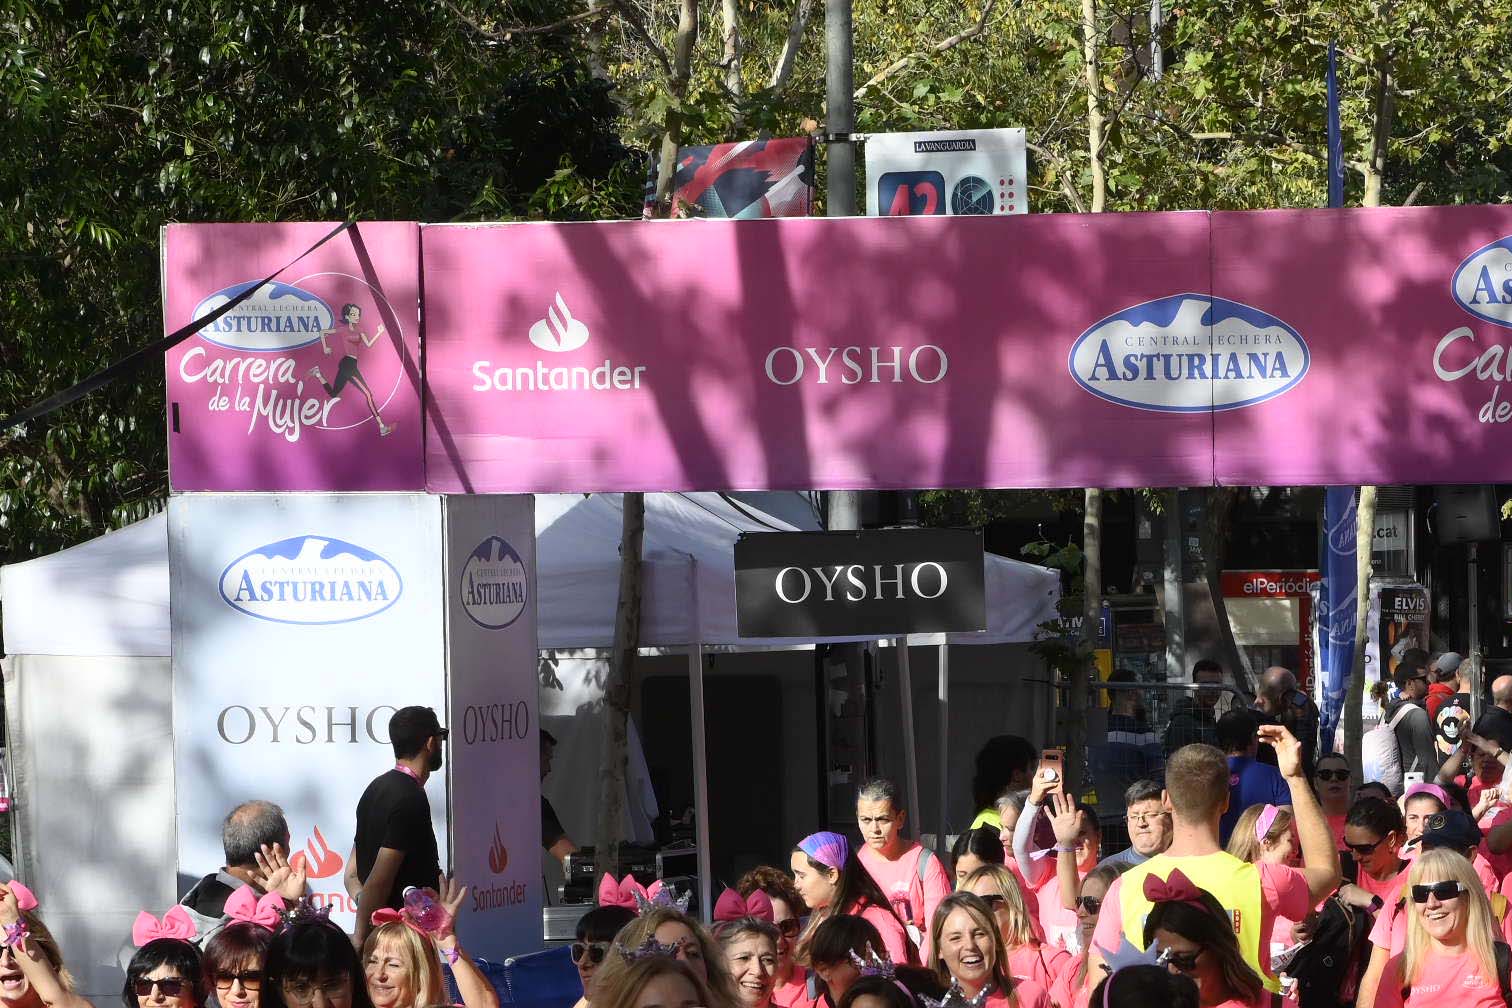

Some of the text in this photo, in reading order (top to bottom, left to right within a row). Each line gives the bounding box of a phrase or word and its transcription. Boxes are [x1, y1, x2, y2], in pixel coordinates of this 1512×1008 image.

[926, 140, 974, 151] VANGUARDIA
[1125, 334, 1283, 347] CENTRAL LECHERA
[179, 346, 296, 384] Carrera
[473, 360, 646, 392] Santander
[765, 344, 949, 386] OYSHO
[1088, 339, 1291, 383] ASTURIANA
[208, 380, 342, 443] de la Mujer
[1478, 385, 1512, 424] de
[233, 569, 390, 602] ASTURIANA
[466, 569, 524, 606] ASTURIANA
[775, 561, 949, 604] OYSHO
[1243, 577, 1320, 593] elPeriódi
[1394, 597, 1425, 609] ELVIS
[217, 705, 401, 745] OYSHO
[463, 700, 529, 745] OYSHO
[472, 880, 528, 912] Santander
